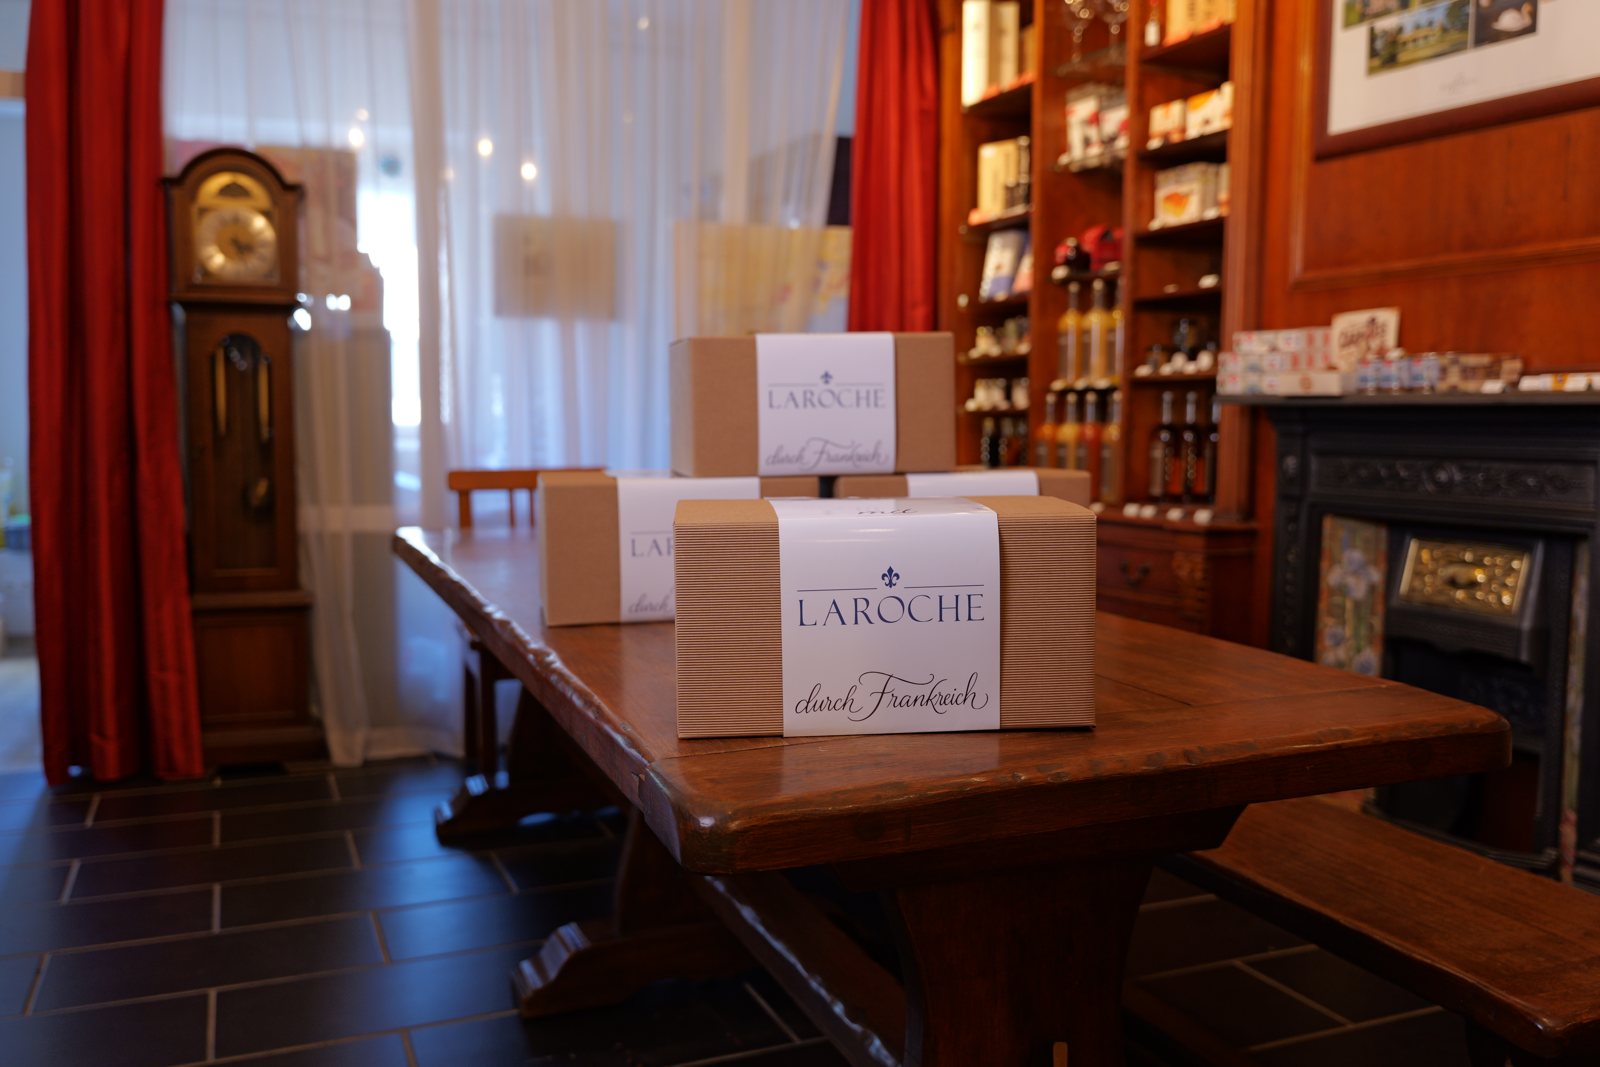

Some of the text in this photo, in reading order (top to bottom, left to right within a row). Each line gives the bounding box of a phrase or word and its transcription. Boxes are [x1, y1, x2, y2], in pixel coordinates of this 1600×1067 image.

[768, 390, 886, 409] LAROCHE
[766, 437, 889, 471] durch Frankreich
[628, 589, 672, 611] durch
[797, 594, 984, 627] LAROCHE
[795, 671, 988, 722] durch Frankreich
